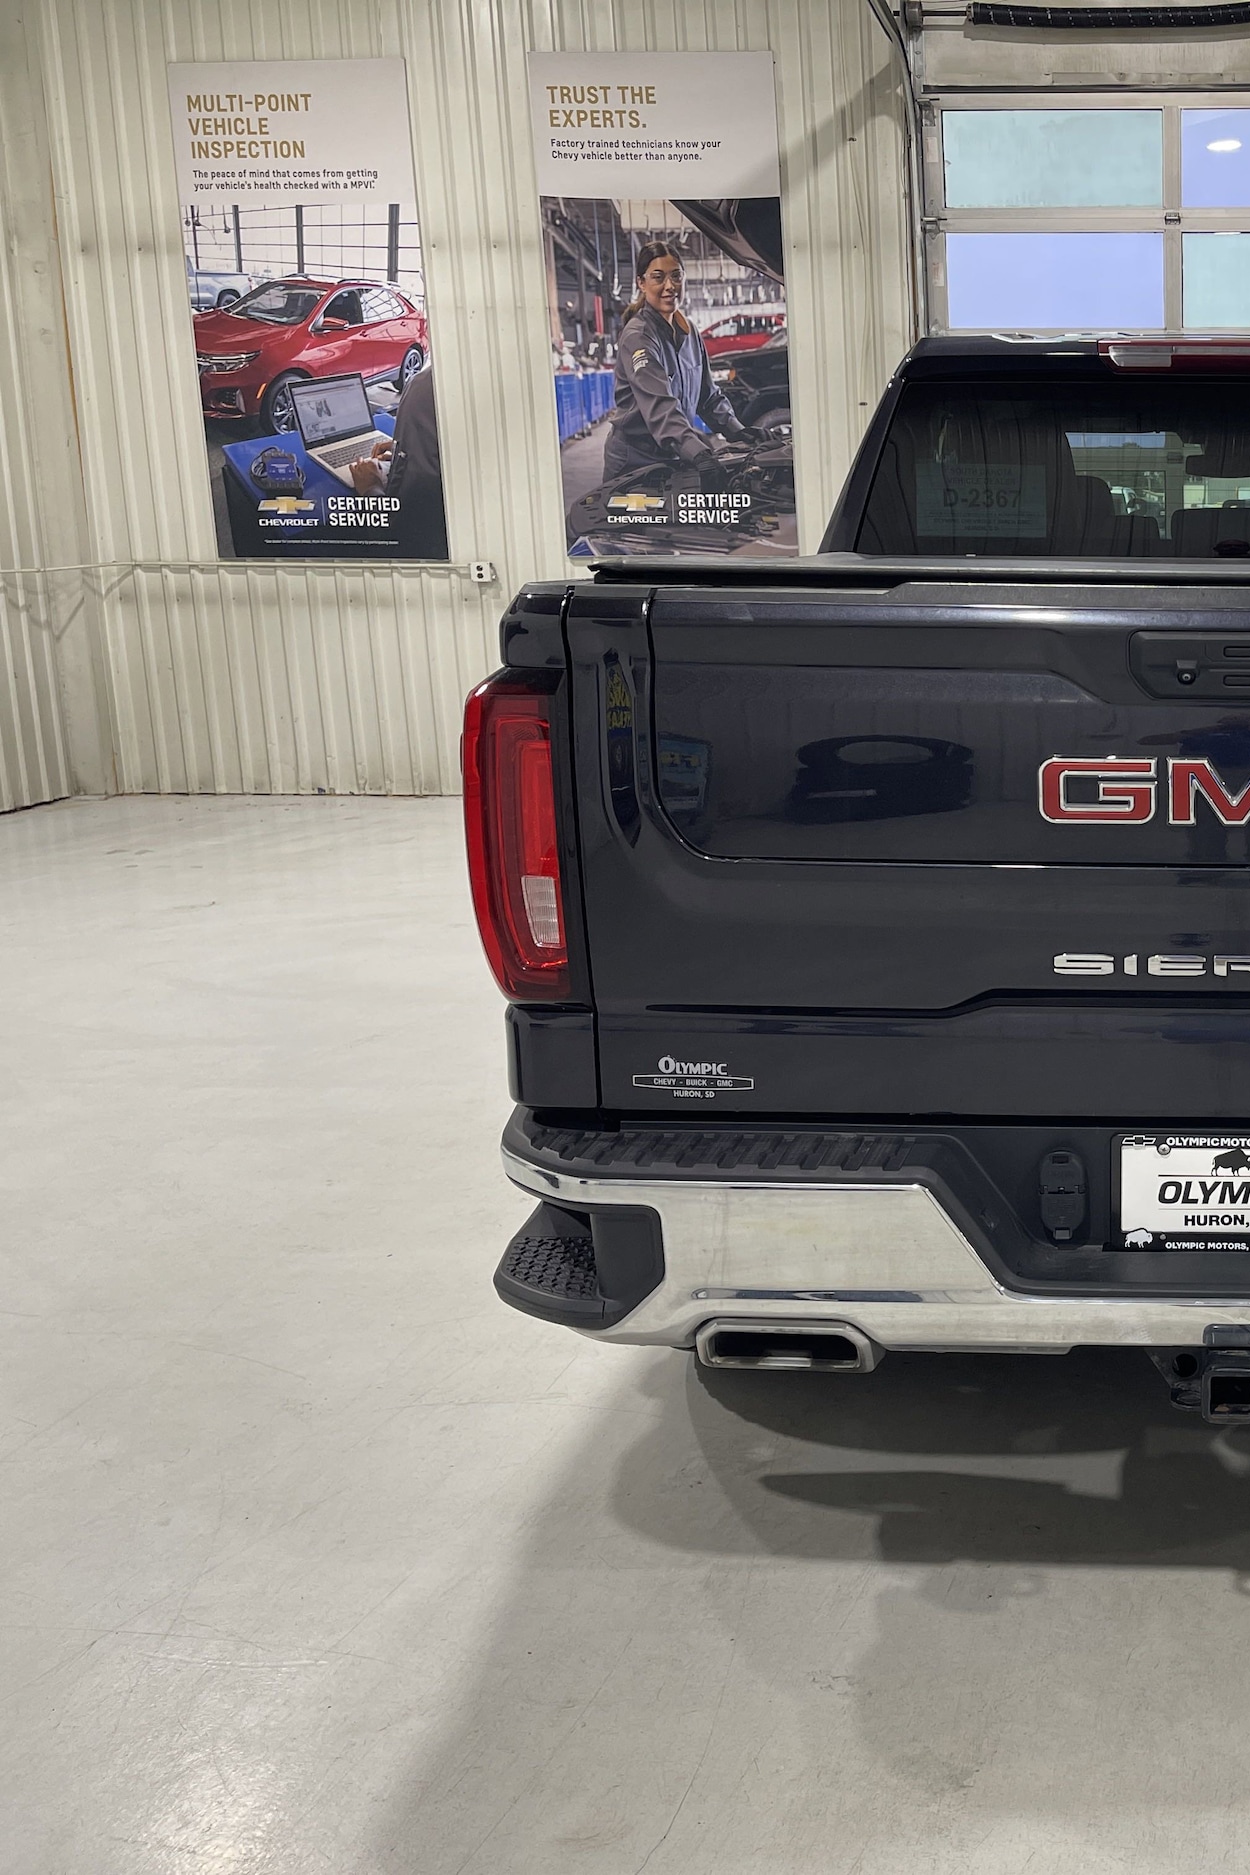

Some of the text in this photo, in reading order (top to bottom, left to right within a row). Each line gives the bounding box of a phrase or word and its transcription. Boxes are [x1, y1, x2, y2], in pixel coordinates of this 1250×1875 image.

[546, 86, 656, 104] TRUST THE
[186, 94, 312, 112] MULTI-POINT
[549, 110, 647, 128] EXPERTS.
[188, 118, 270, 136] VEHICLE
[191, 140, 306, 159] INSPECTION
[550, 138, 722, 151] Factory trained technicians know your
[551, 150, 702, 163] Chevy vehicle better than anyone.
[192, 169, 378, 180] The peace of mind that comes from getting
[194, 182, 213, 192] your
[215, 181, 252, 190] vehicle's
[254, 181, 281, 190] health
[283, 181, 319, 190] checked
[321, 181, 341, 190] with
[327, 496, 400, 512] CERTIFIED
[678, 493, 750, 508] CERTIFIED
[943, 488, 1020, 508] D-2367
[258, 518, 320, 527] CHEVROLET
[329, 513, 390, 527] SERVICE
[607, 515, 668, 524] CHEVROLET
[678, 509, 739, 524] SERVICE
[658, 1055, 728, 1076] OLYMPIC
[653, 1078, 677, 1086] CHEVY
[686, 1079, 708, 1087] BUICK
[673, 1090, 703, 1098] HURON,
[1184, 1214, 1250, 1228] HURON,
[1165, 1242, 1205, 1250] OLYMPIC
[1207, 1242, 1250, 1252] MOTORS,
